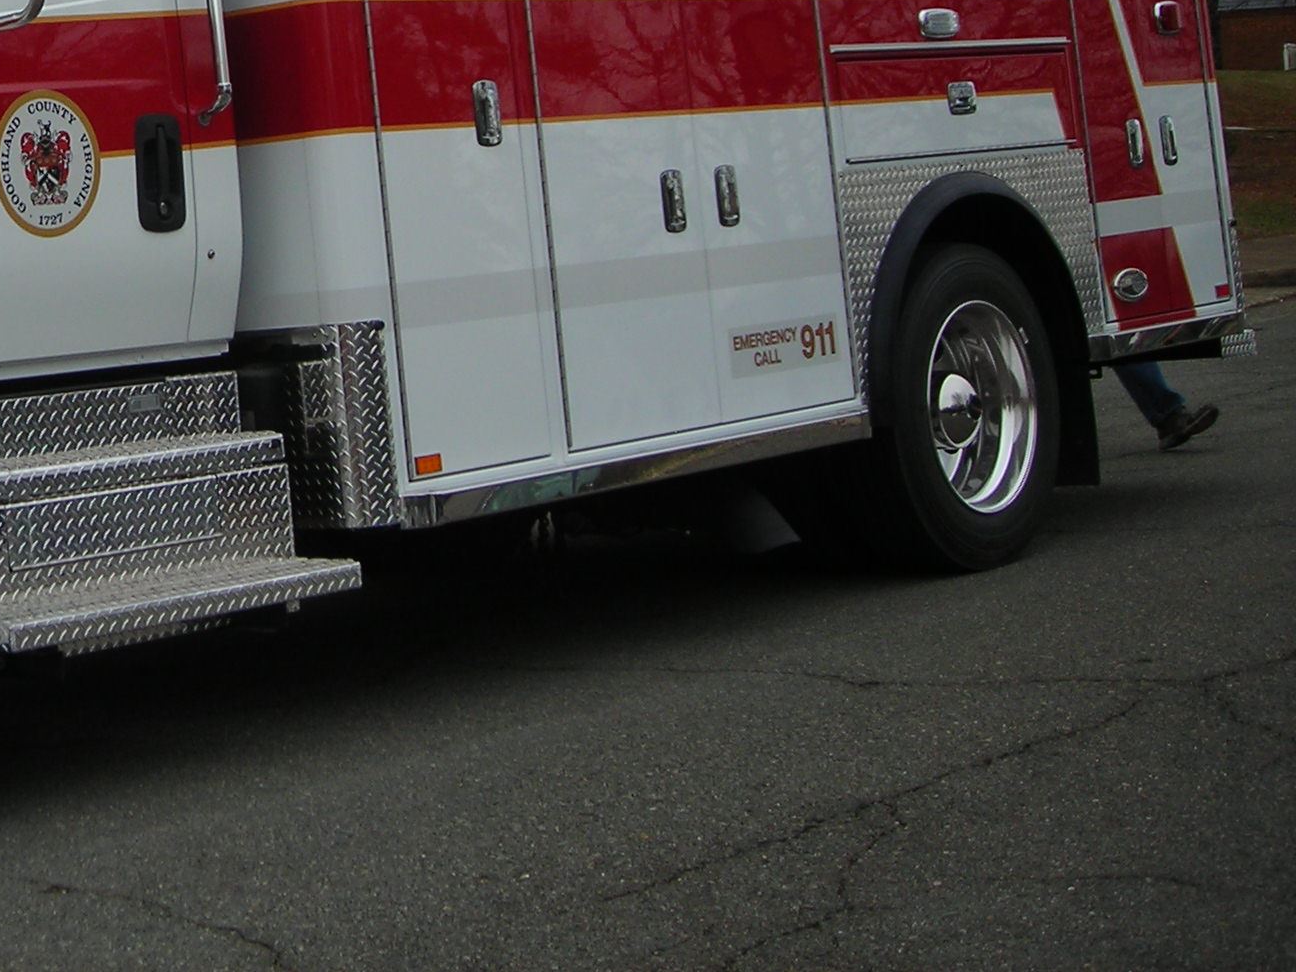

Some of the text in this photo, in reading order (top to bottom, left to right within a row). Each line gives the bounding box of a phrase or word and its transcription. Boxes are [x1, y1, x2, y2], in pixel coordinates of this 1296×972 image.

[1, 101, 94, 214] GOOCHLAND COUNTY VIRGINIA
[38, 213, 64, 226] 1727
[732, 326, 798, 351] EMERGENCY
[800, 320, 836, 360] 911
[753, 348, 782, 367] CALL
